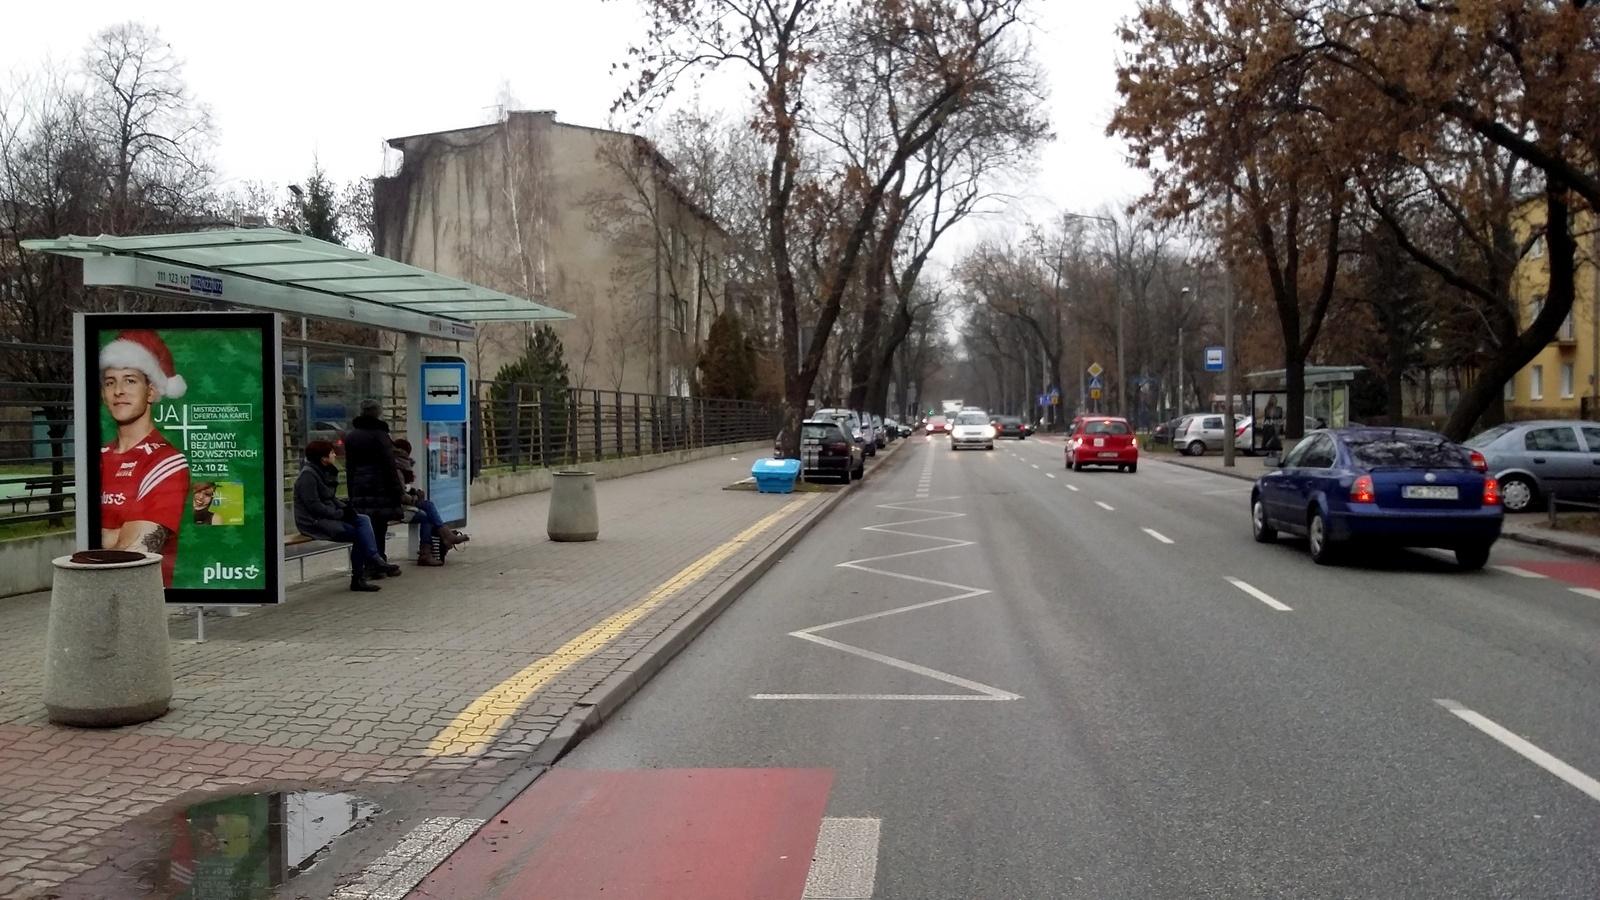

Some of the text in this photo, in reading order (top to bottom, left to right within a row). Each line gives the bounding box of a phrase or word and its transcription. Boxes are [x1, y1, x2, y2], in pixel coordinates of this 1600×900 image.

[157, 272, 165, 280] 111
[168, 273, 178, 283] 123
[180, 276, 189, 285] 147
[154, 404, 179, 423] JA
[209, 441, 236, 449] LIMITU
[191, 450, 205, 458] DO
[192, 464, 229, 472] ZA 10 ZŁ
[203, 562, 243, 584] plus
